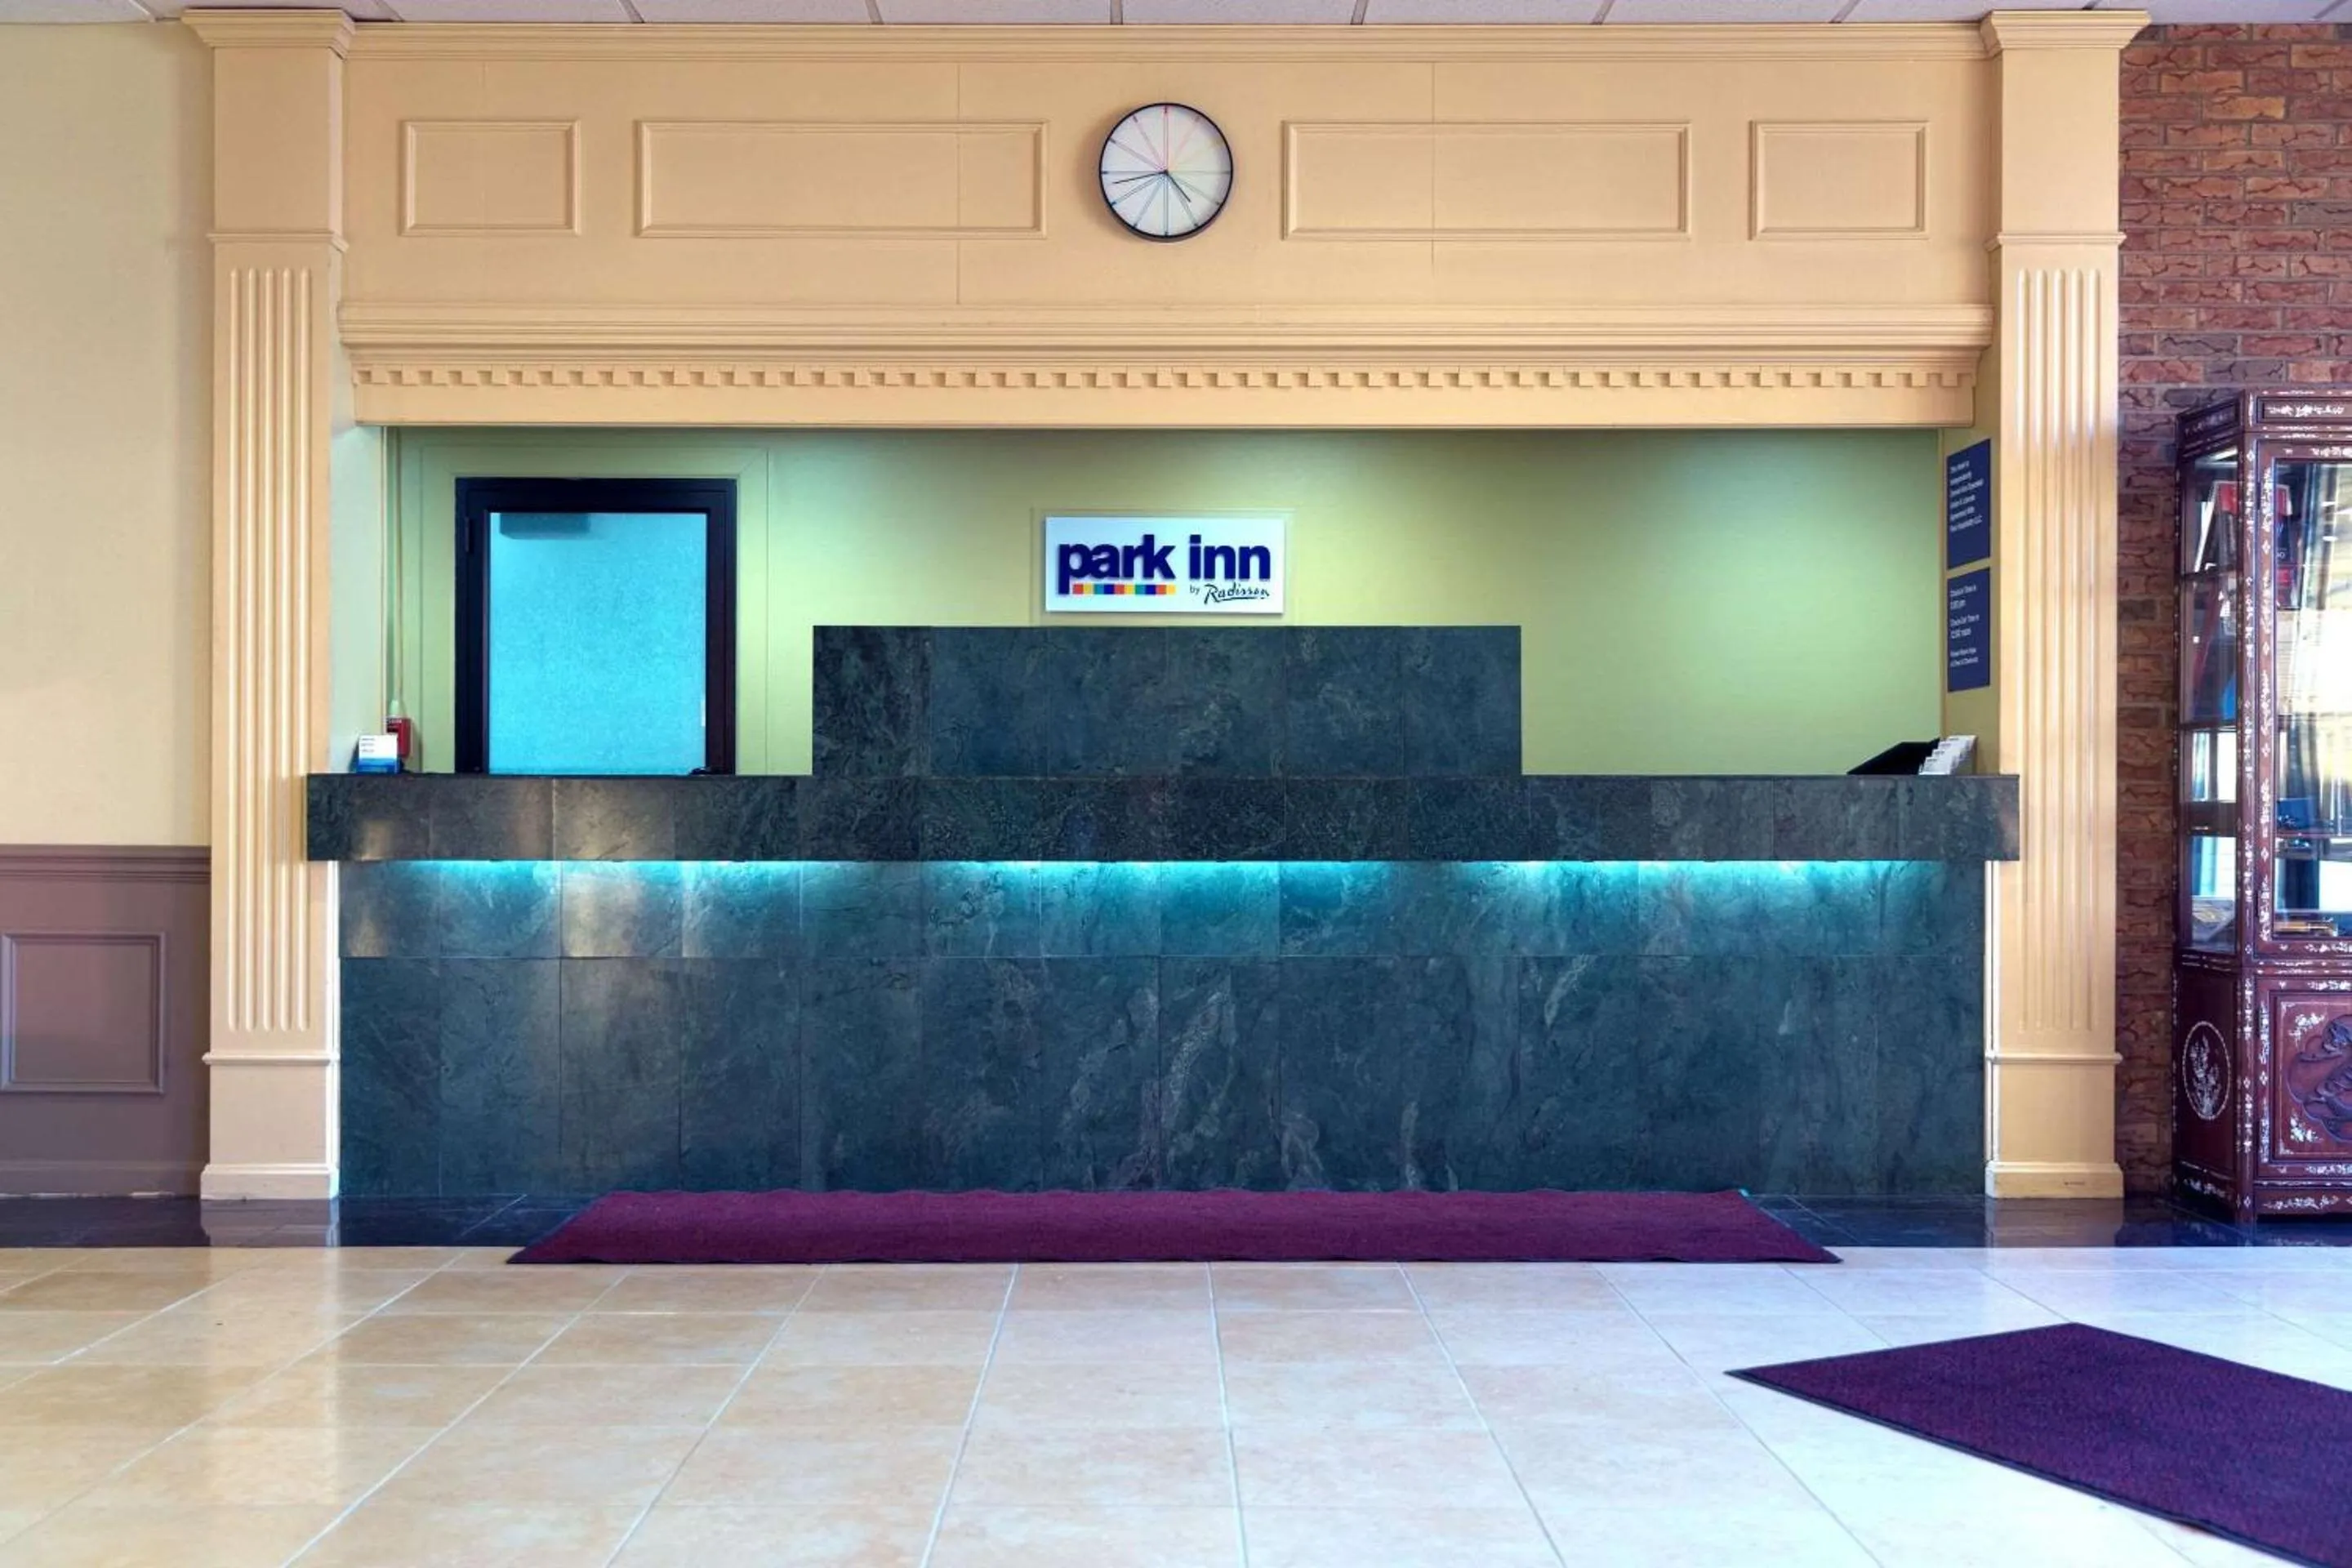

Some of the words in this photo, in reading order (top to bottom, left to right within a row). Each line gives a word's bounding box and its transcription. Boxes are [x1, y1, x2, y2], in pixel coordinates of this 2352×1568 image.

[1058, 534, 1177, 595] park
[1189, 534, 1271, 580] inn
[1189, 586, 1200, 595] by
[1204, 581, 1270, 604] Radisson
